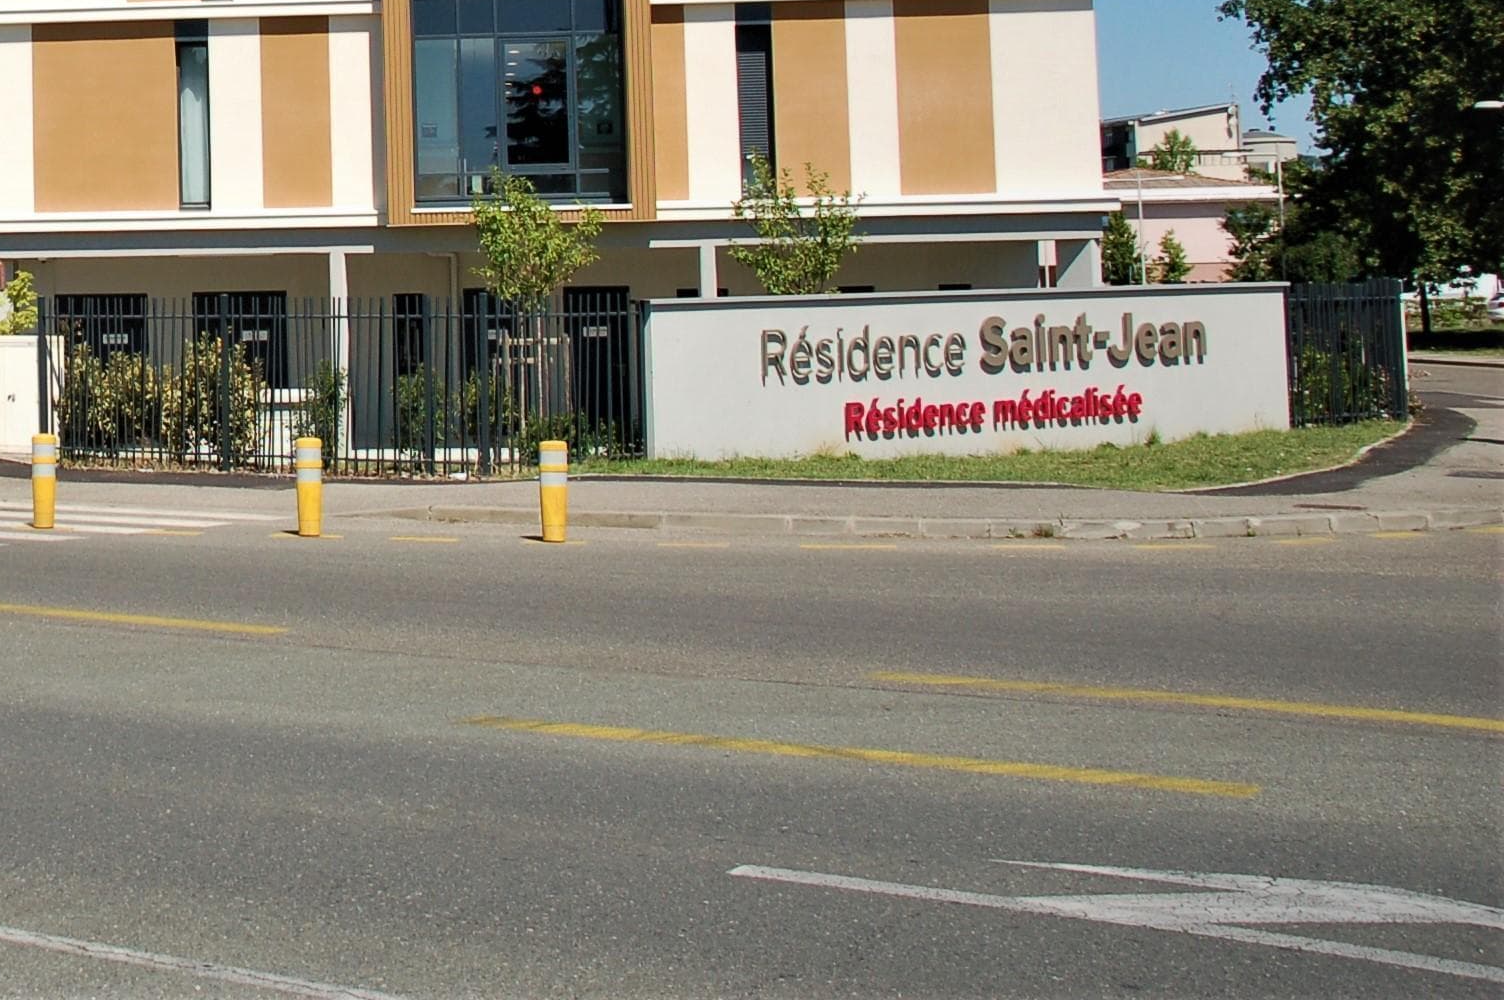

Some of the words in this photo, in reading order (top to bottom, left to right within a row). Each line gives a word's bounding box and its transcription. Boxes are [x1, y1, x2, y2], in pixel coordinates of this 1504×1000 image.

[761, 325, 966, 383] Résidence
[980, 312, 1207, 373] Saint-Jean
[844, 398, 985, 439] Résidence
[993, 385, 1143, 428] médicalisée
